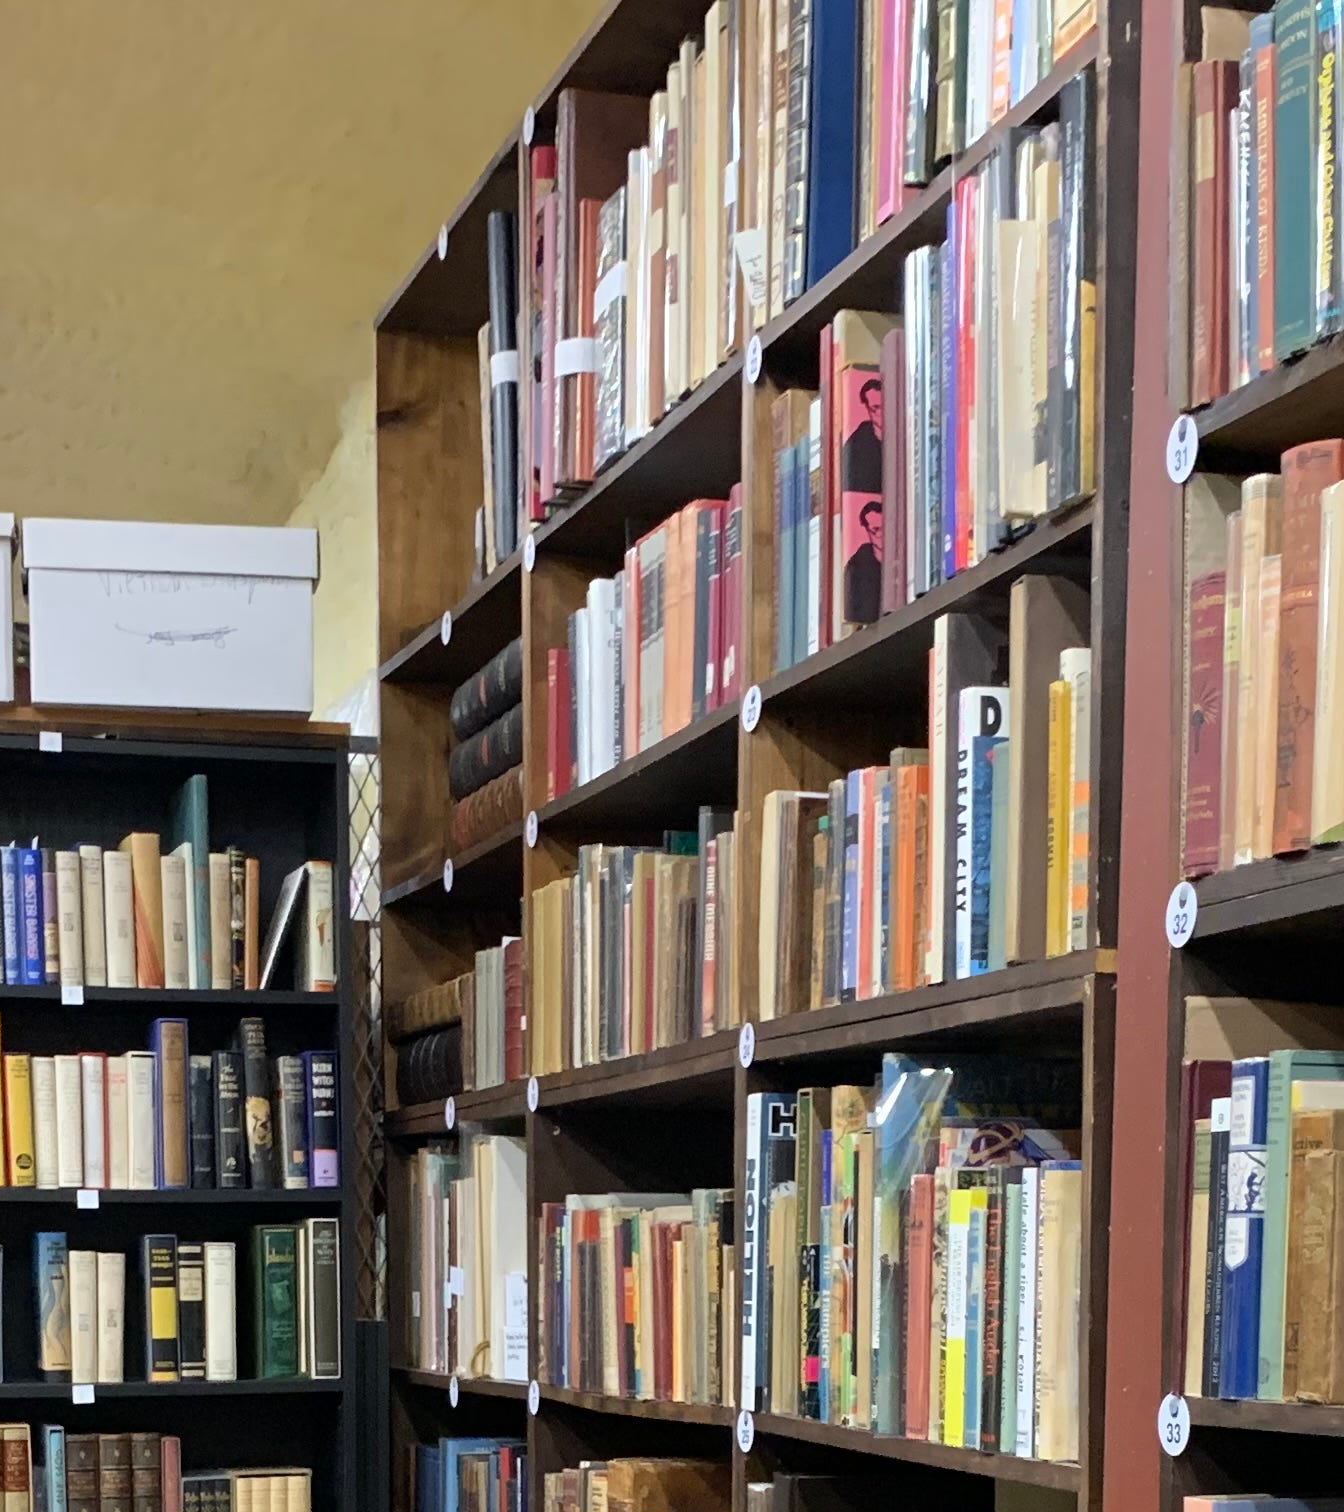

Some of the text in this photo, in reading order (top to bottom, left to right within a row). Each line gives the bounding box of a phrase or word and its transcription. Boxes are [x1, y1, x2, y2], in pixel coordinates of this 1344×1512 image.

[1173, 447, 1189, 471] 31
[956, 749, 968, 912] DREAM CITY
[1172, 914, 1188, 935] 32
[985, 1245, 1002, 1311] English
[984, 1319, 1001, 1376] Auden
[1165, 1422, 1182, 1445] 33
